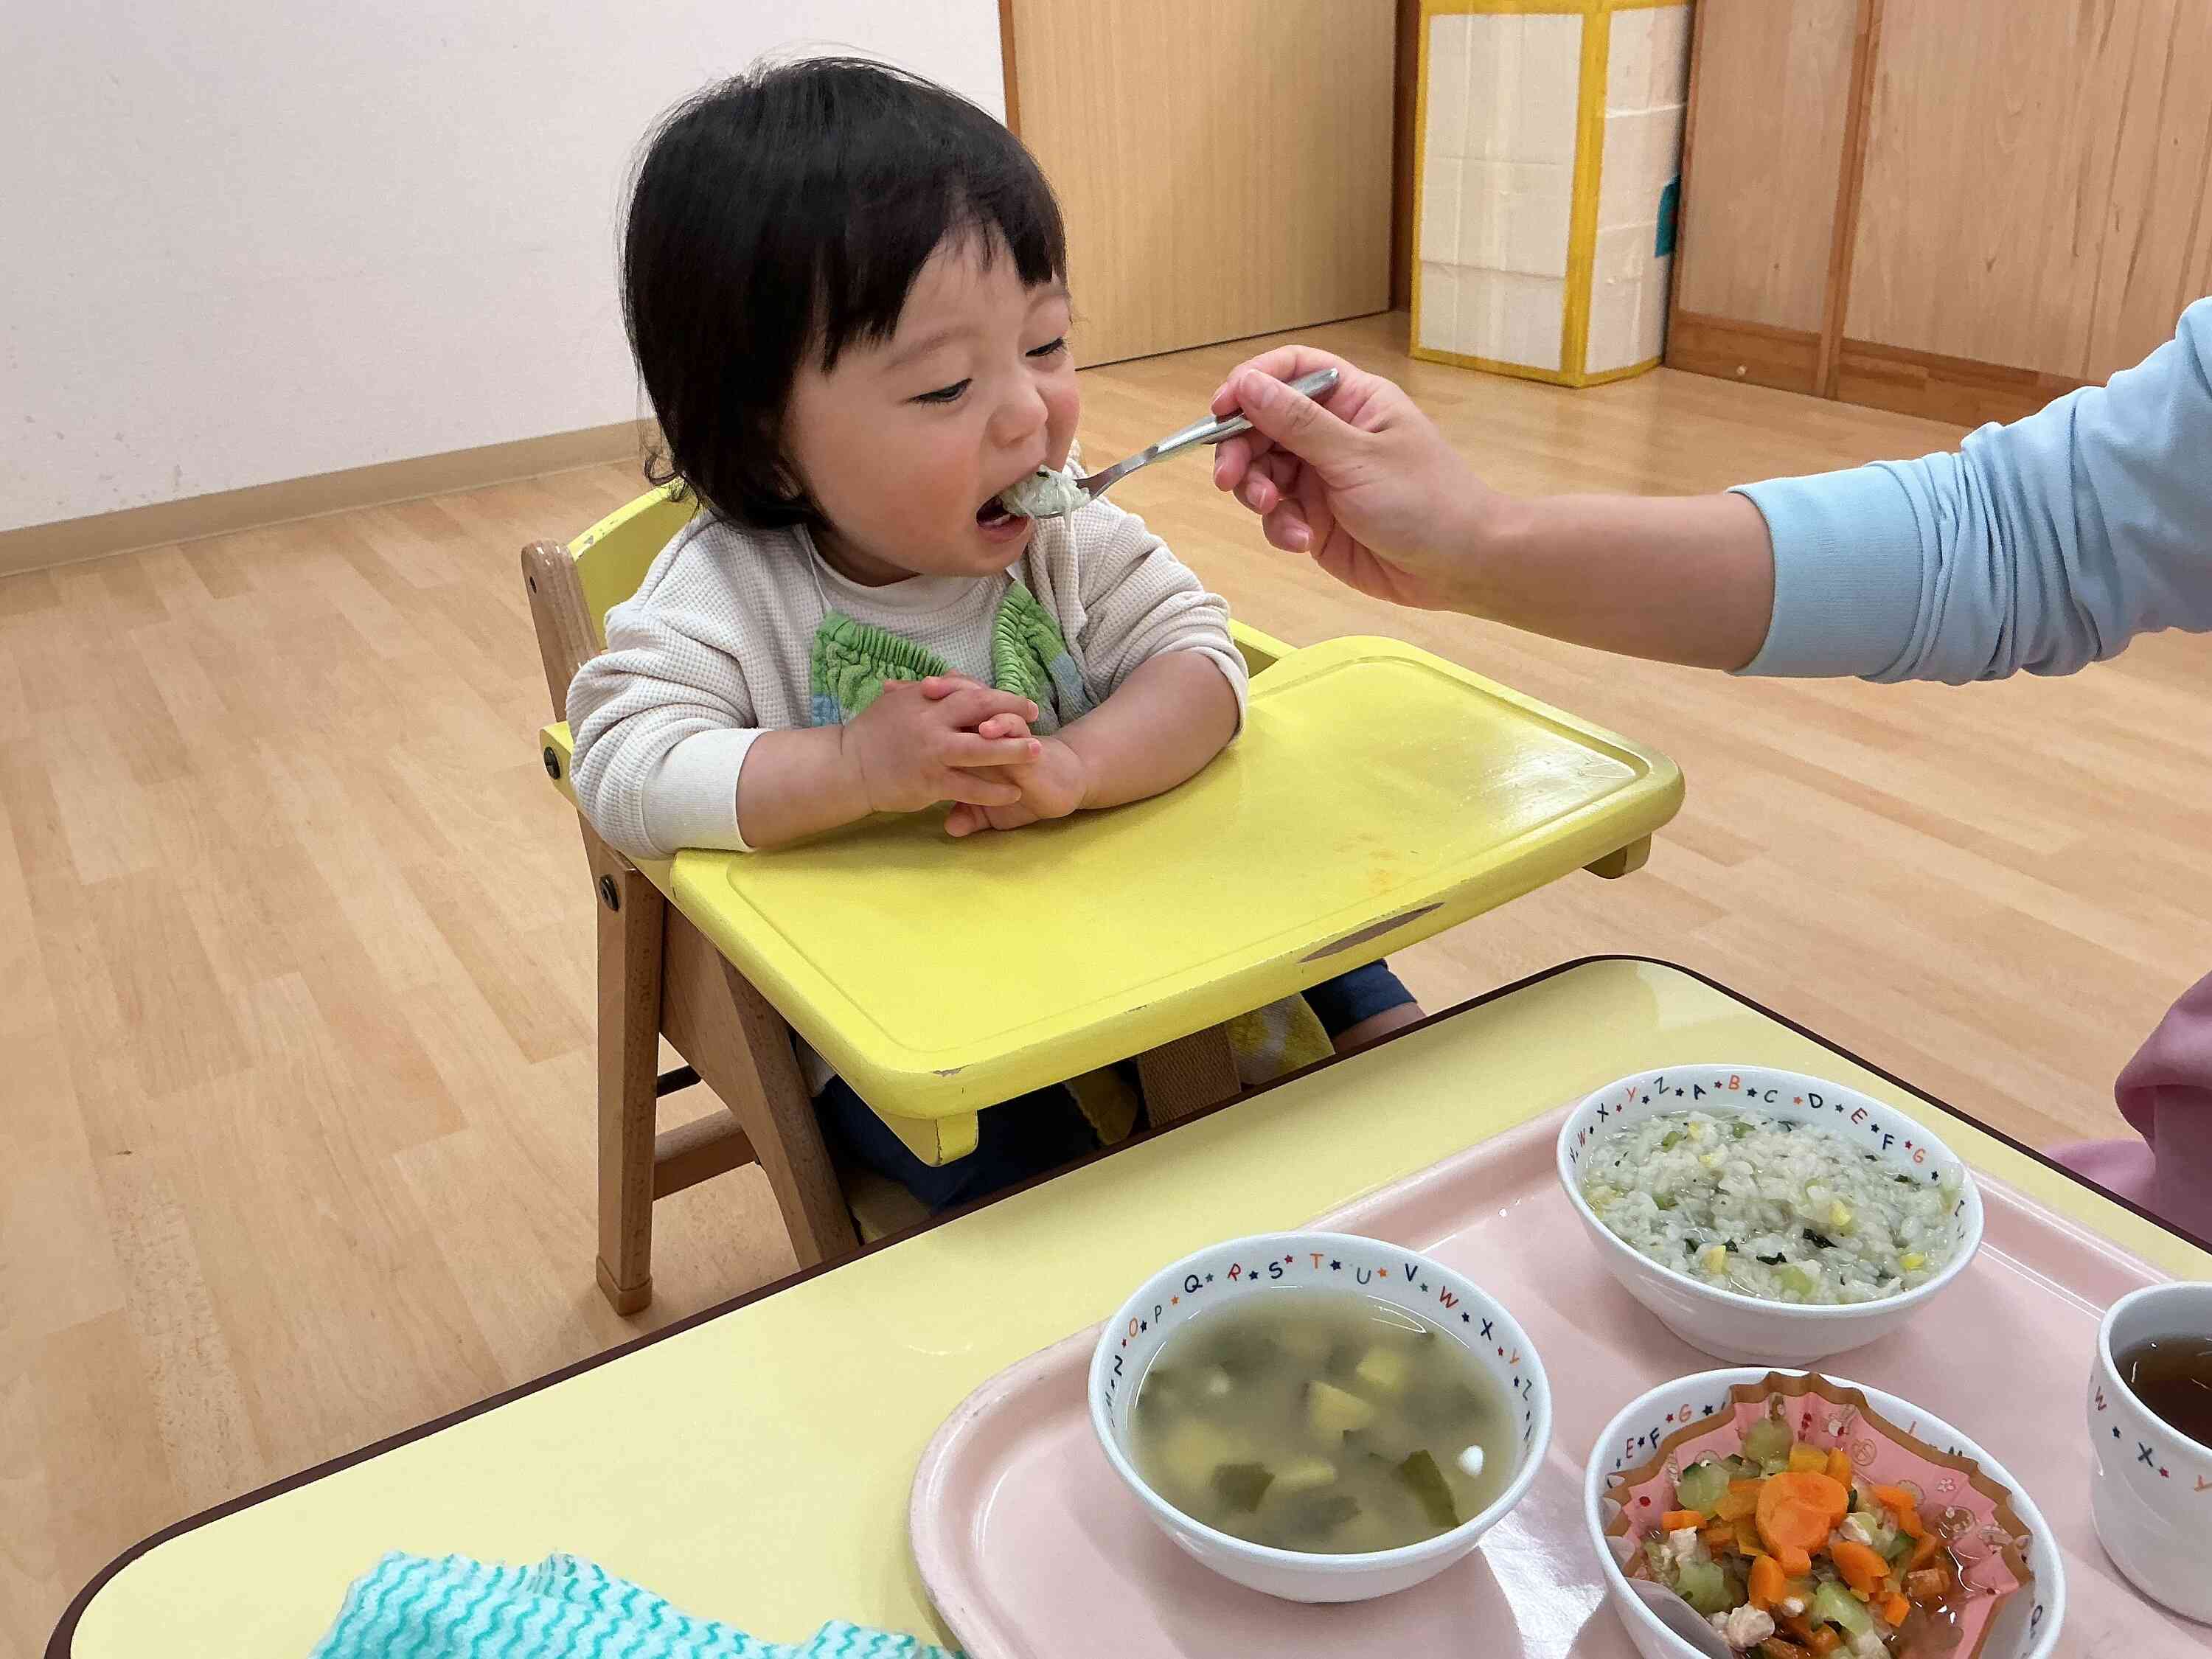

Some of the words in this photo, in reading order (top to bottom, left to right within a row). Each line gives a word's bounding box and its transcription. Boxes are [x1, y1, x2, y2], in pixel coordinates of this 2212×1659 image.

[1597, 1103, 1609, 1122] X
[1627, 1087, 1635, 1102] Y
[1654, 1077, 1669, 1094] Z
[1694, 1084, 1706, 1099] A
[1728, 1074, 1740, 1090] B
[1764, 1090, 1778, 1103] C
[1808, 1093, 1823, 1108] D
[1851, 1107, 1868, 1124] E
[1882, 1133, 1894, 1150] F
[1913, 1148, 1927, 1164] G
[1155, 1305, 1163, 1323] P
[1184, 1274, 1203, 1293] Q
[1227, 1263, 1241, 1281] R
[1268, 1262, 1283, 1279] S
[1310, 1253, 1324, 1269] T
[1356, 1267, 1371, 1284] U
[1405, 1263, 1418, 1281] V
[1439, 1286, 1458, 1308] W
[1480, 1318, 1493, 1340] X
[1626, 1438, 1634, 1458] E
[1649, 1427, 1660, 1449] F
[1679, 1403, 1692, 1423] G
[2138, 1441, 2154, 1467] X
